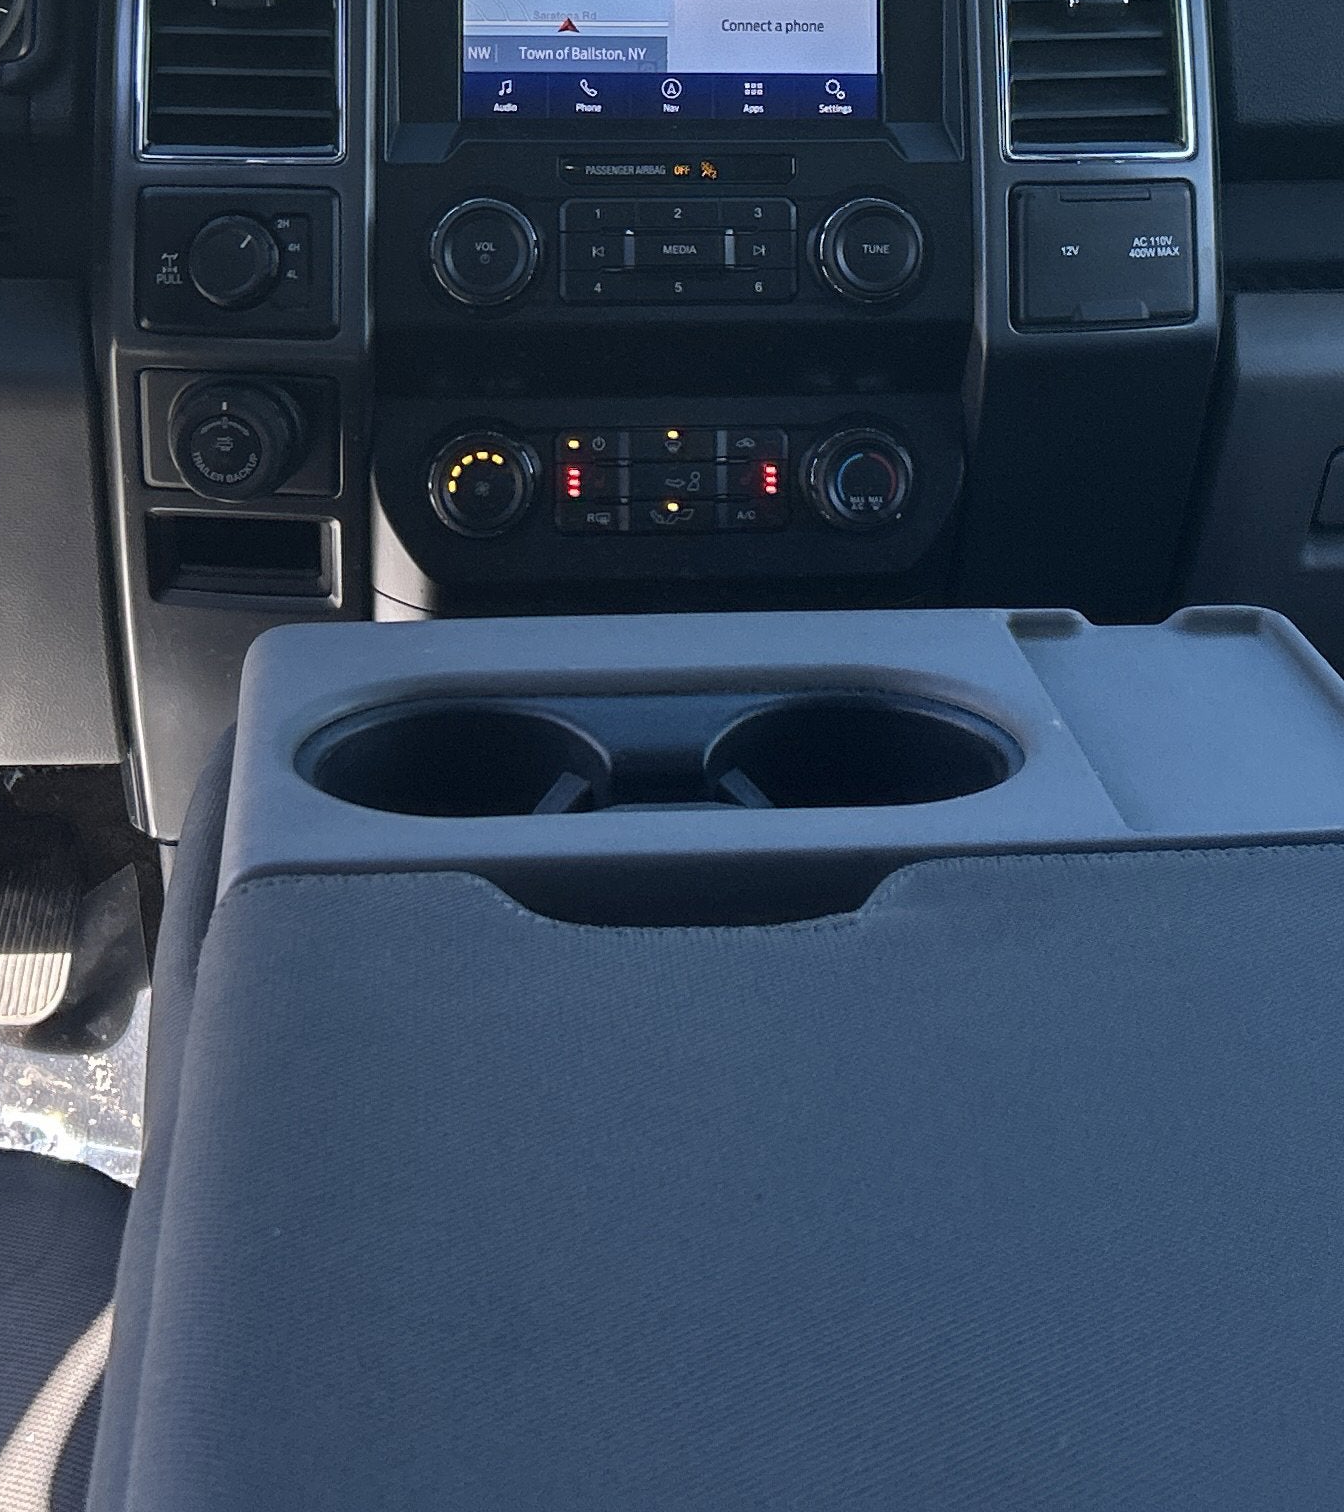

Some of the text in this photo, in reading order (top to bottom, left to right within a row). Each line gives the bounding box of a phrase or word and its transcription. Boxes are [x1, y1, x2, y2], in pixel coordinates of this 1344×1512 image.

[582, 10, 597, 20] Rd
[721, 19, 824, 34] Connect a phone
[468, 46, 491, 59] NW
[519, 46, 647, 62] Town of Ballston, NY
[493, 103, 518, 112] Audio
[575, 103, 602, 113] Phone
[663, 103, 680, 113] Nav
[743, 104, 764, 114] Apps
[818, 104, 853, 115] Settings
[585, 164, 691, 175] PASSENGER AIRBAG OFF
[595, 209, 601, 219] 1
[673, 208, 682, 219] 2
[754, 208, 762, 218] 3
[276, 219, 290, 229] 2H
[475, 241, 496, 251] VOL
[1133, 236, 1173, 247] AC 110V
[662, 245, 697, 255] MEDIA
[862, 244, 890, 254] TUNE
[1061, 246, 1079, 256] 12V
[1129, 247, 1180, 258] 400W MAX
[156, 274, 183, 285] PULL
[594, 282, 602, 293] 4
[674, 282, 682, 293] 5
[755, 282, 763, 293] 6
[192, 452, 258, 483] TRAILER BACKUP
[736, 511, 756, 520] A/C
